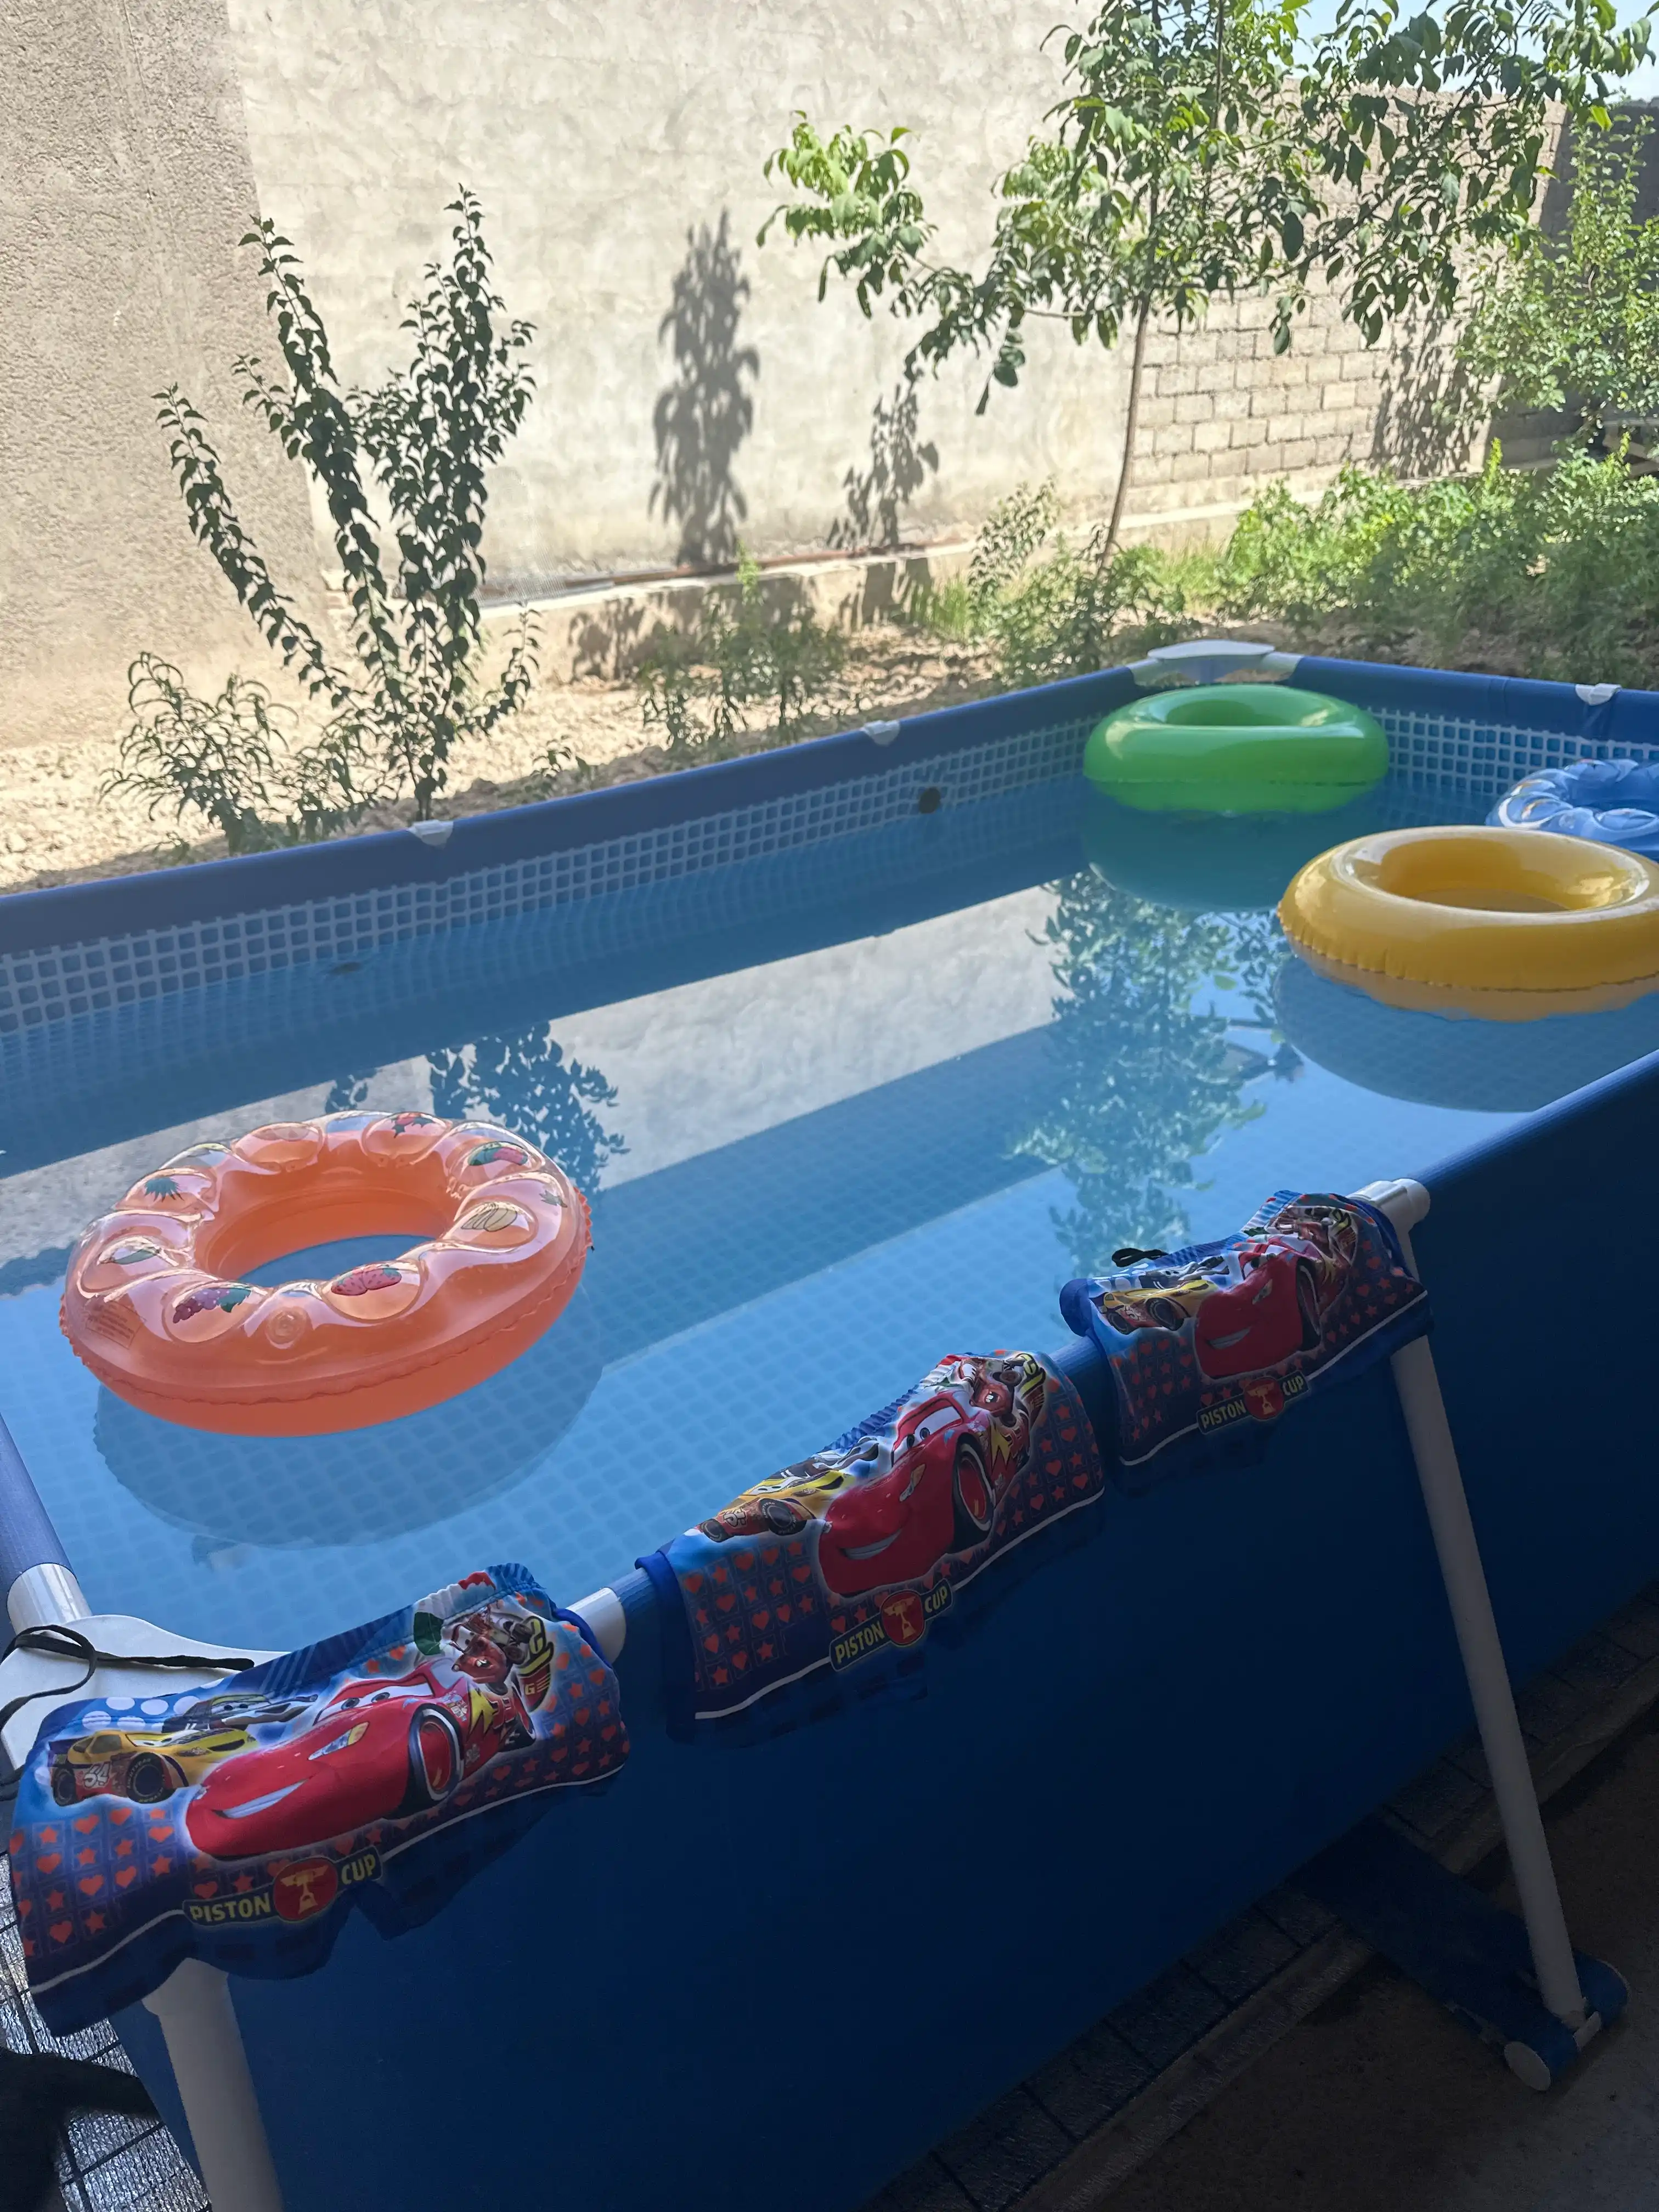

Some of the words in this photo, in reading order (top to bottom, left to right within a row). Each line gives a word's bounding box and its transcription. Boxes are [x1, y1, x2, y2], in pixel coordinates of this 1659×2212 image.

[1200, 1400, 1246, 1429] PISTON
[1282, 1376, 1304, 1396] CUP
[834, 1620, 885, 1664] PISTON
[924, 1586, 947, 1613] CUP
[83, 1763, 110, 1788] 54
[190, 1893, 270, 1922] PISTON
[341, 1854, 376, 1885] CUP
